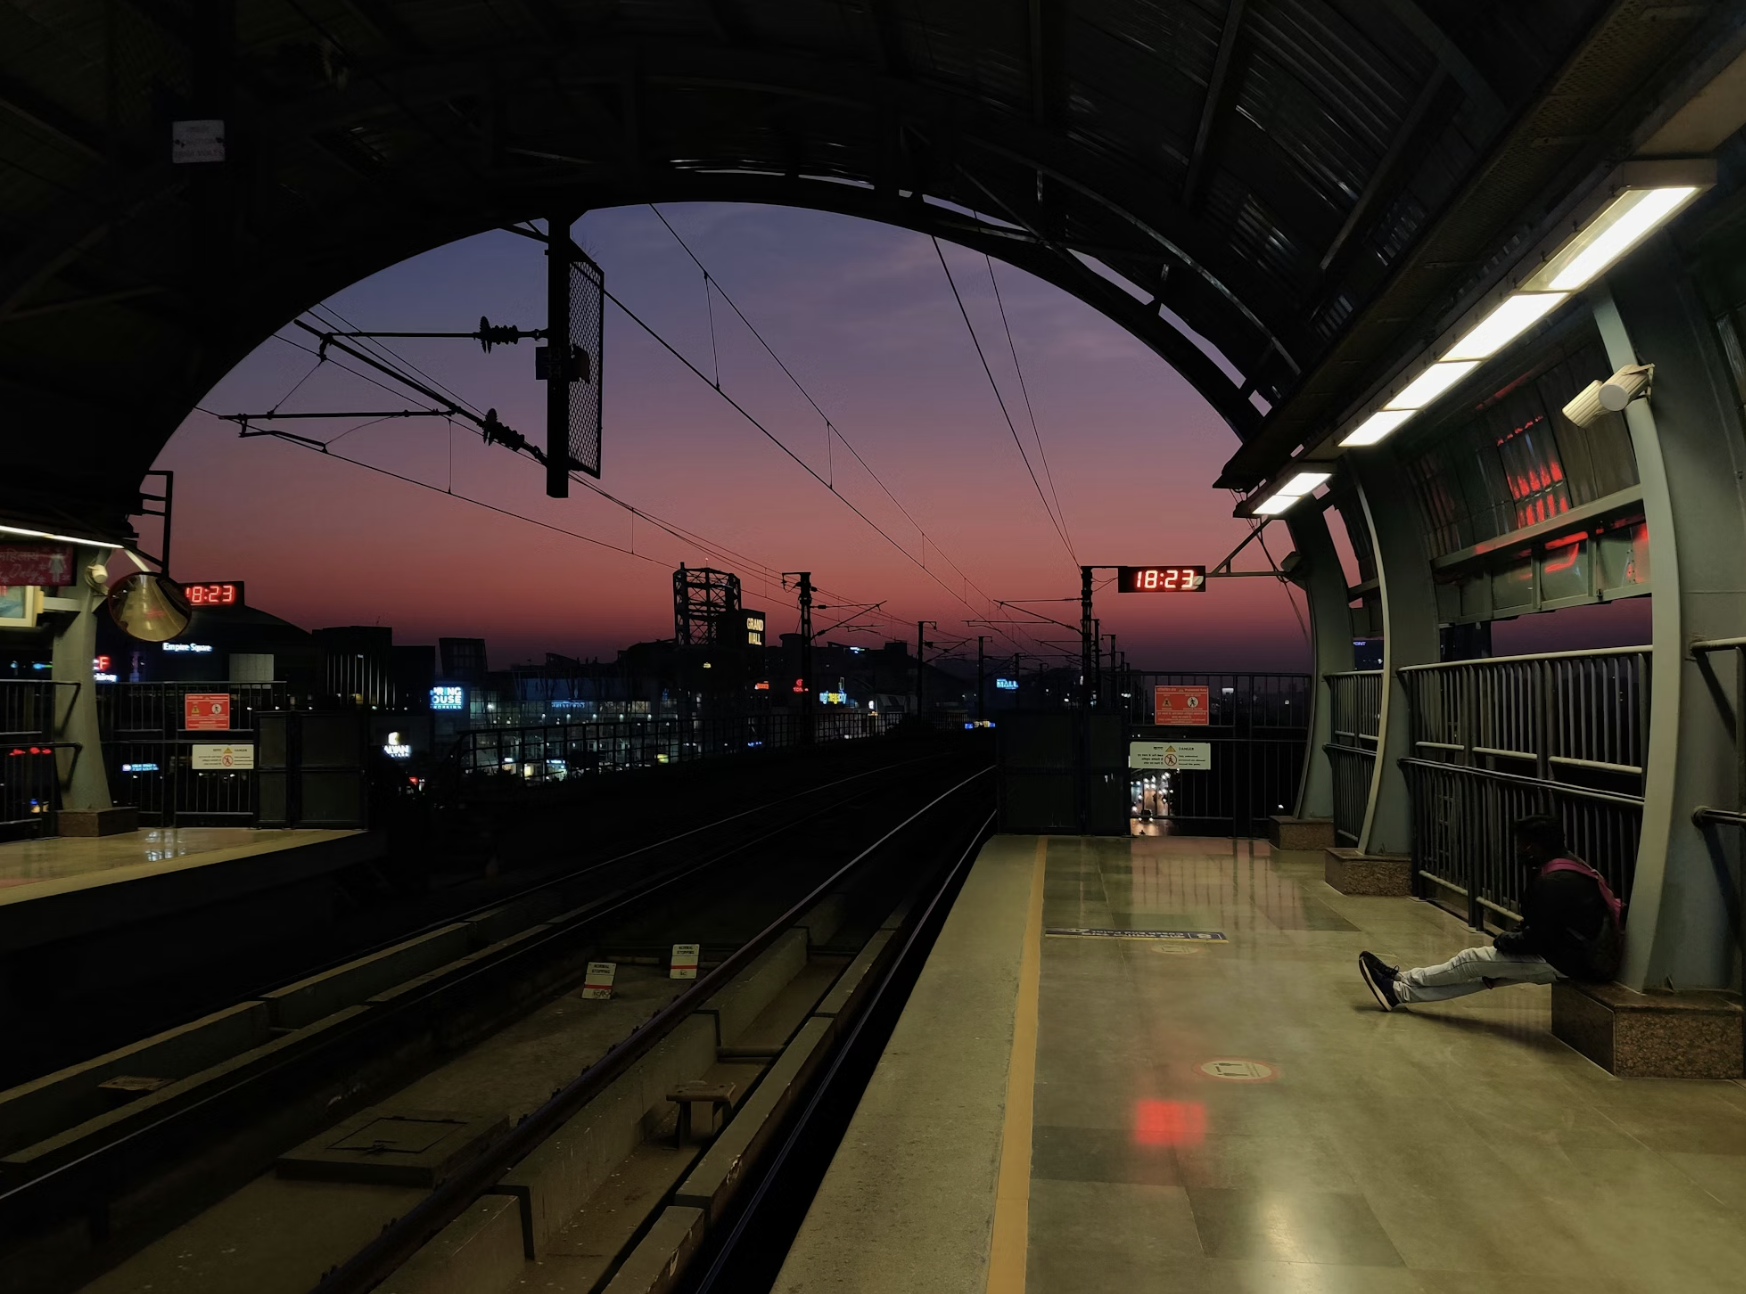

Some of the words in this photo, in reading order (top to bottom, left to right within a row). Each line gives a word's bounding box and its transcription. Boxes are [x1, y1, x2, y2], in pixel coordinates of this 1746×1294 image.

[1136, 569, 1195, 589] 18:23
[163, 642, 190, 652] Empire
[190, 643, 213, 653] Square
[431, 695, 462, 704] OUSE
